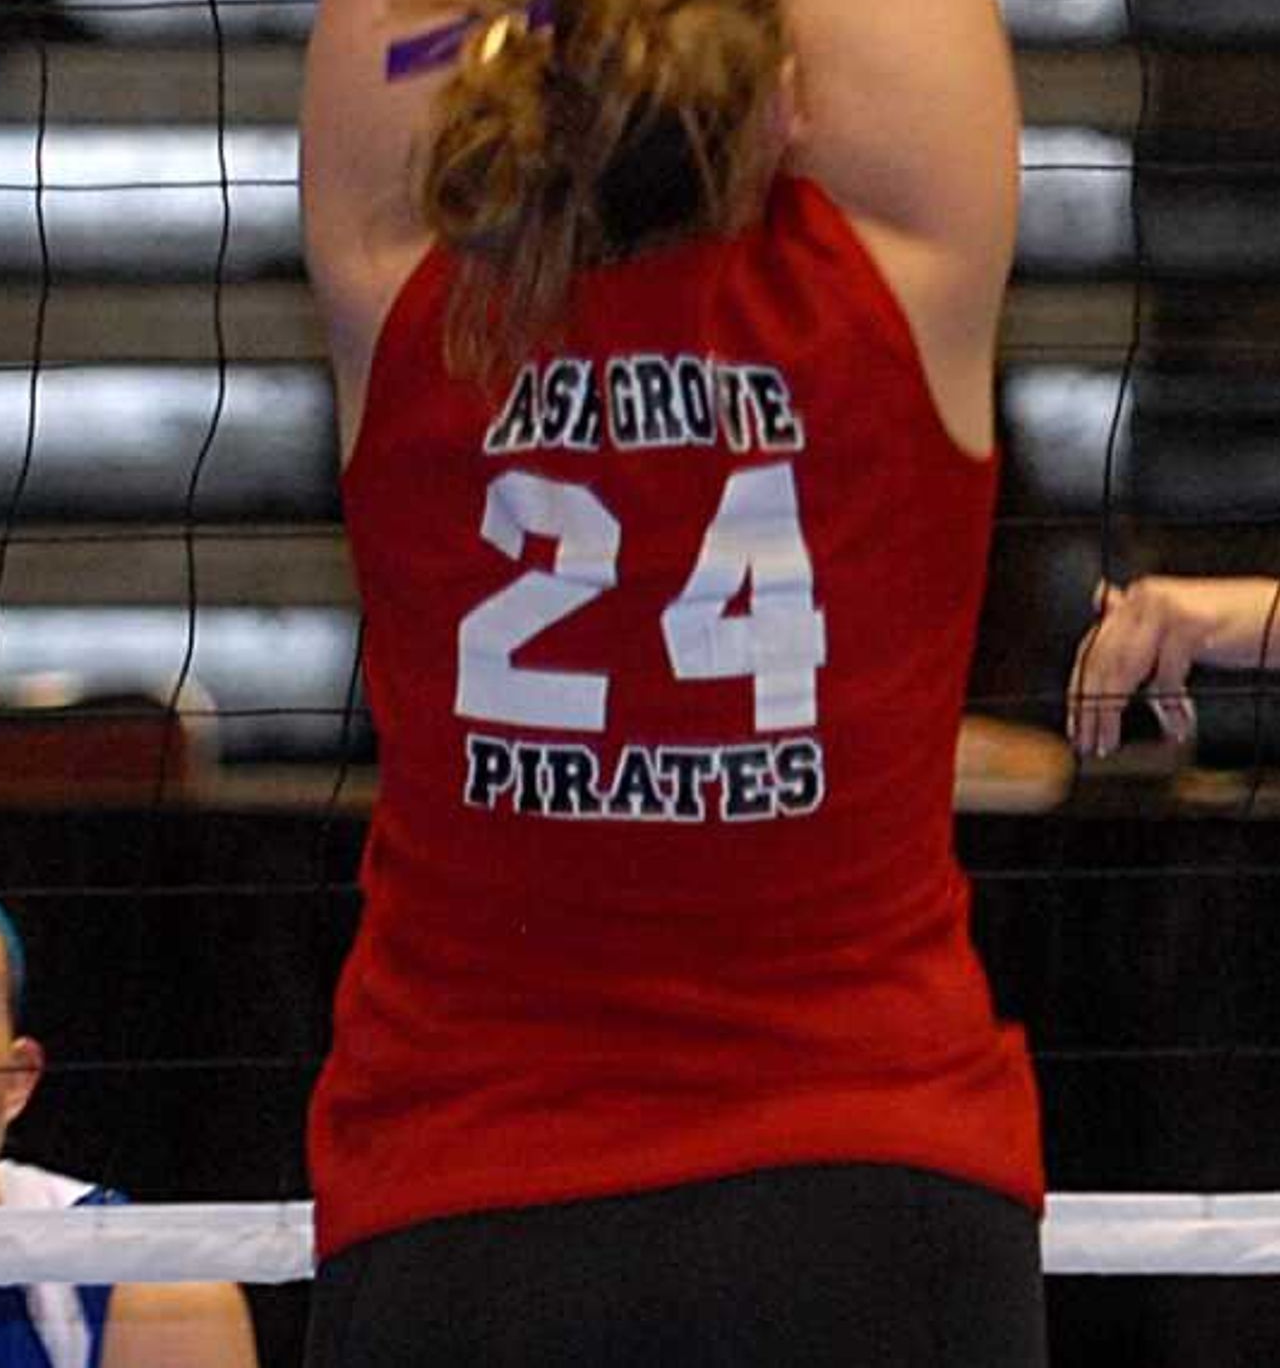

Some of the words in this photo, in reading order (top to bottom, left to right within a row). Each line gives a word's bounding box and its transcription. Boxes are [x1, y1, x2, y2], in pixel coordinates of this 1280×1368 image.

[604, 352, 805, 454] GROVE
[454, 461, 827, 733] 24
[464, 733, 826, 823] PIRATES
